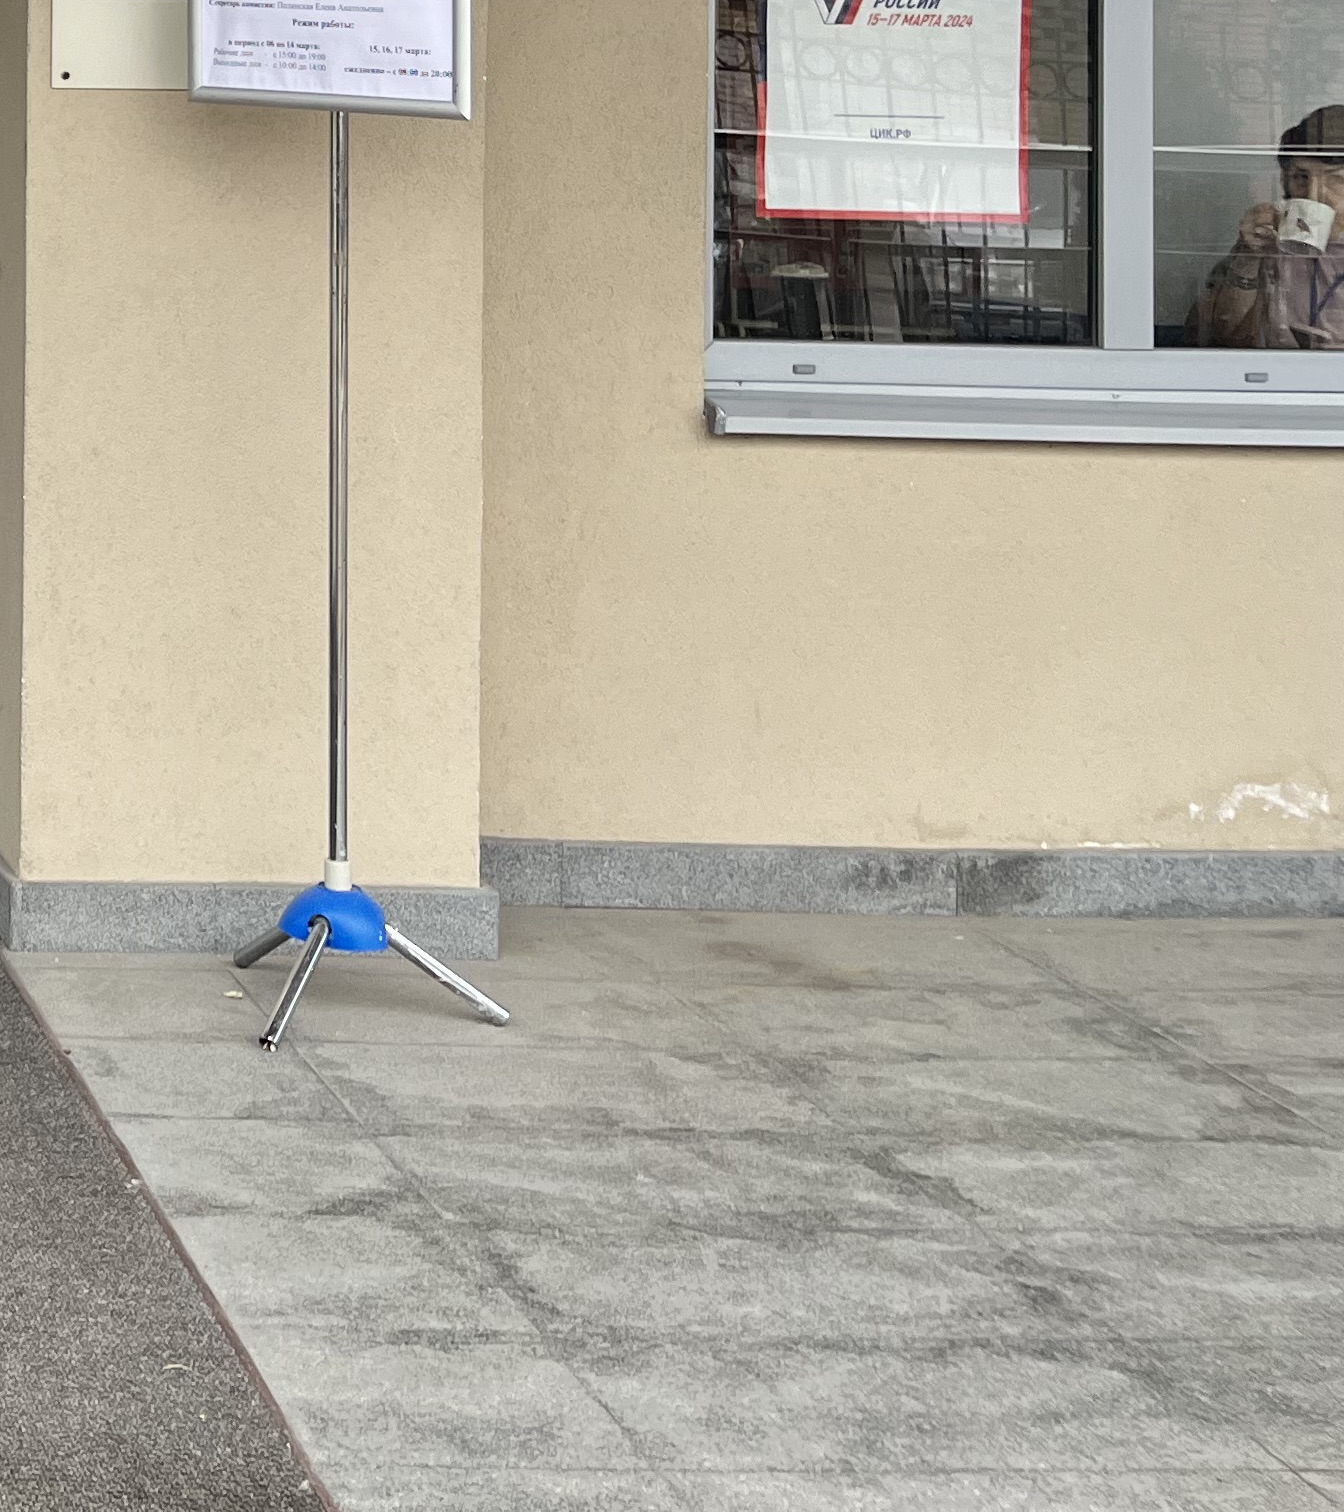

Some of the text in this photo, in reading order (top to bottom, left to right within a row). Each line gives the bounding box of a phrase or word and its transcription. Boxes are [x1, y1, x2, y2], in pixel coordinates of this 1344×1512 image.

[901, 14, 942, 27] МАРТА
[944, 14, 974, 27] 2024
[870, 128, 912, 139] ЦИК.РФ
